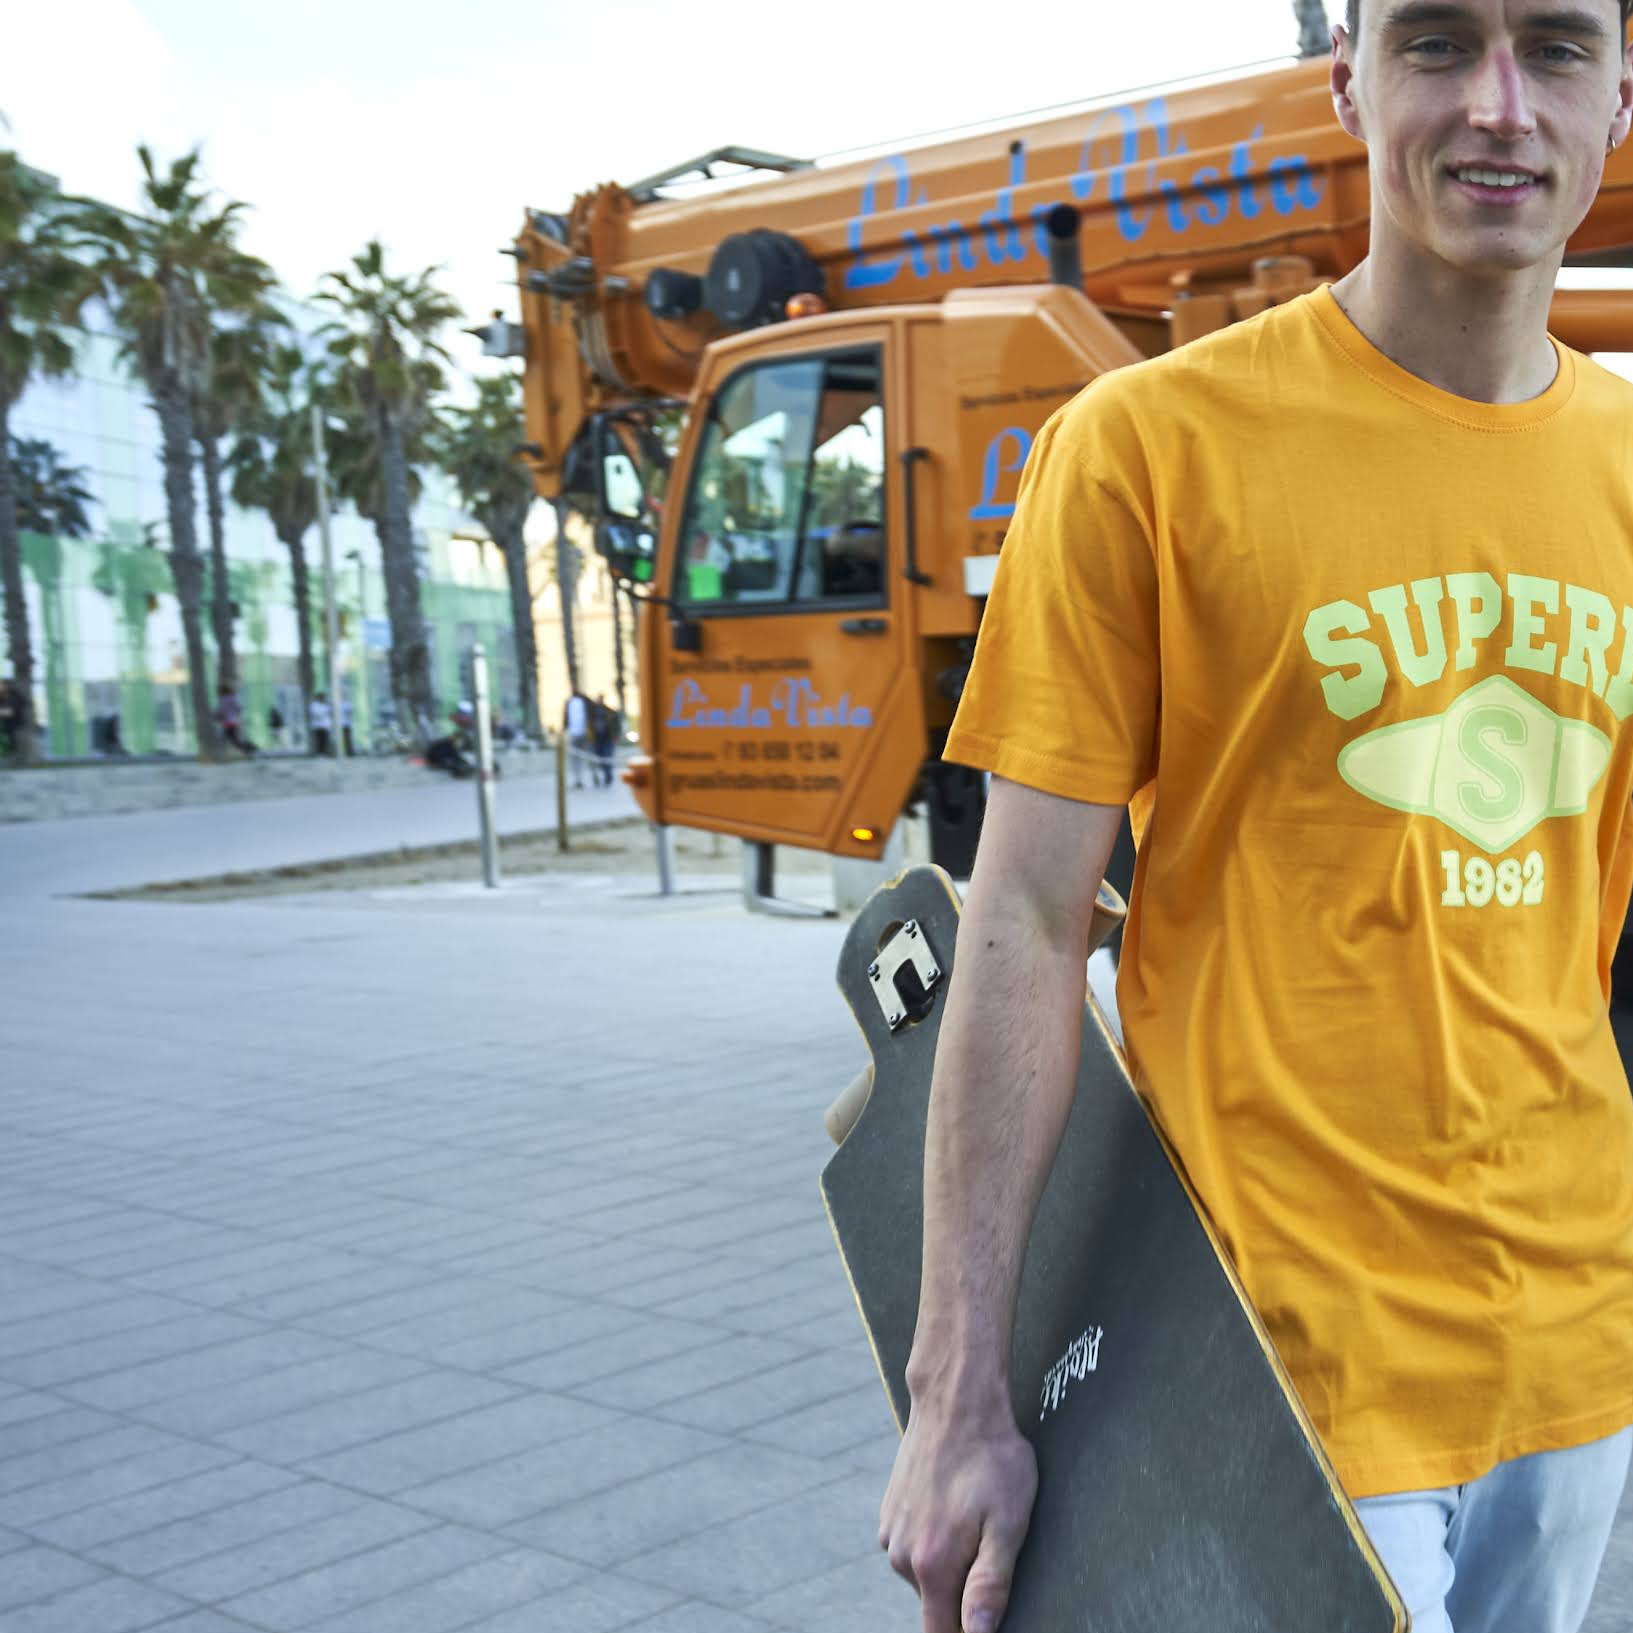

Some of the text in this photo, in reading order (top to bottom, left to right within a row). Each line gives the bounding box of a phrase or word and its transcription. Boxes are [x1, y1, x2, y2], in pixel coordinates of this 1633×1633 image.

[1070, 96, 1327, 241] Vista
[665, 676, 875, 728] Linda Vista
[1457, 704, 1528, 824] S
[1440, 850, 1545, 908] 1982
